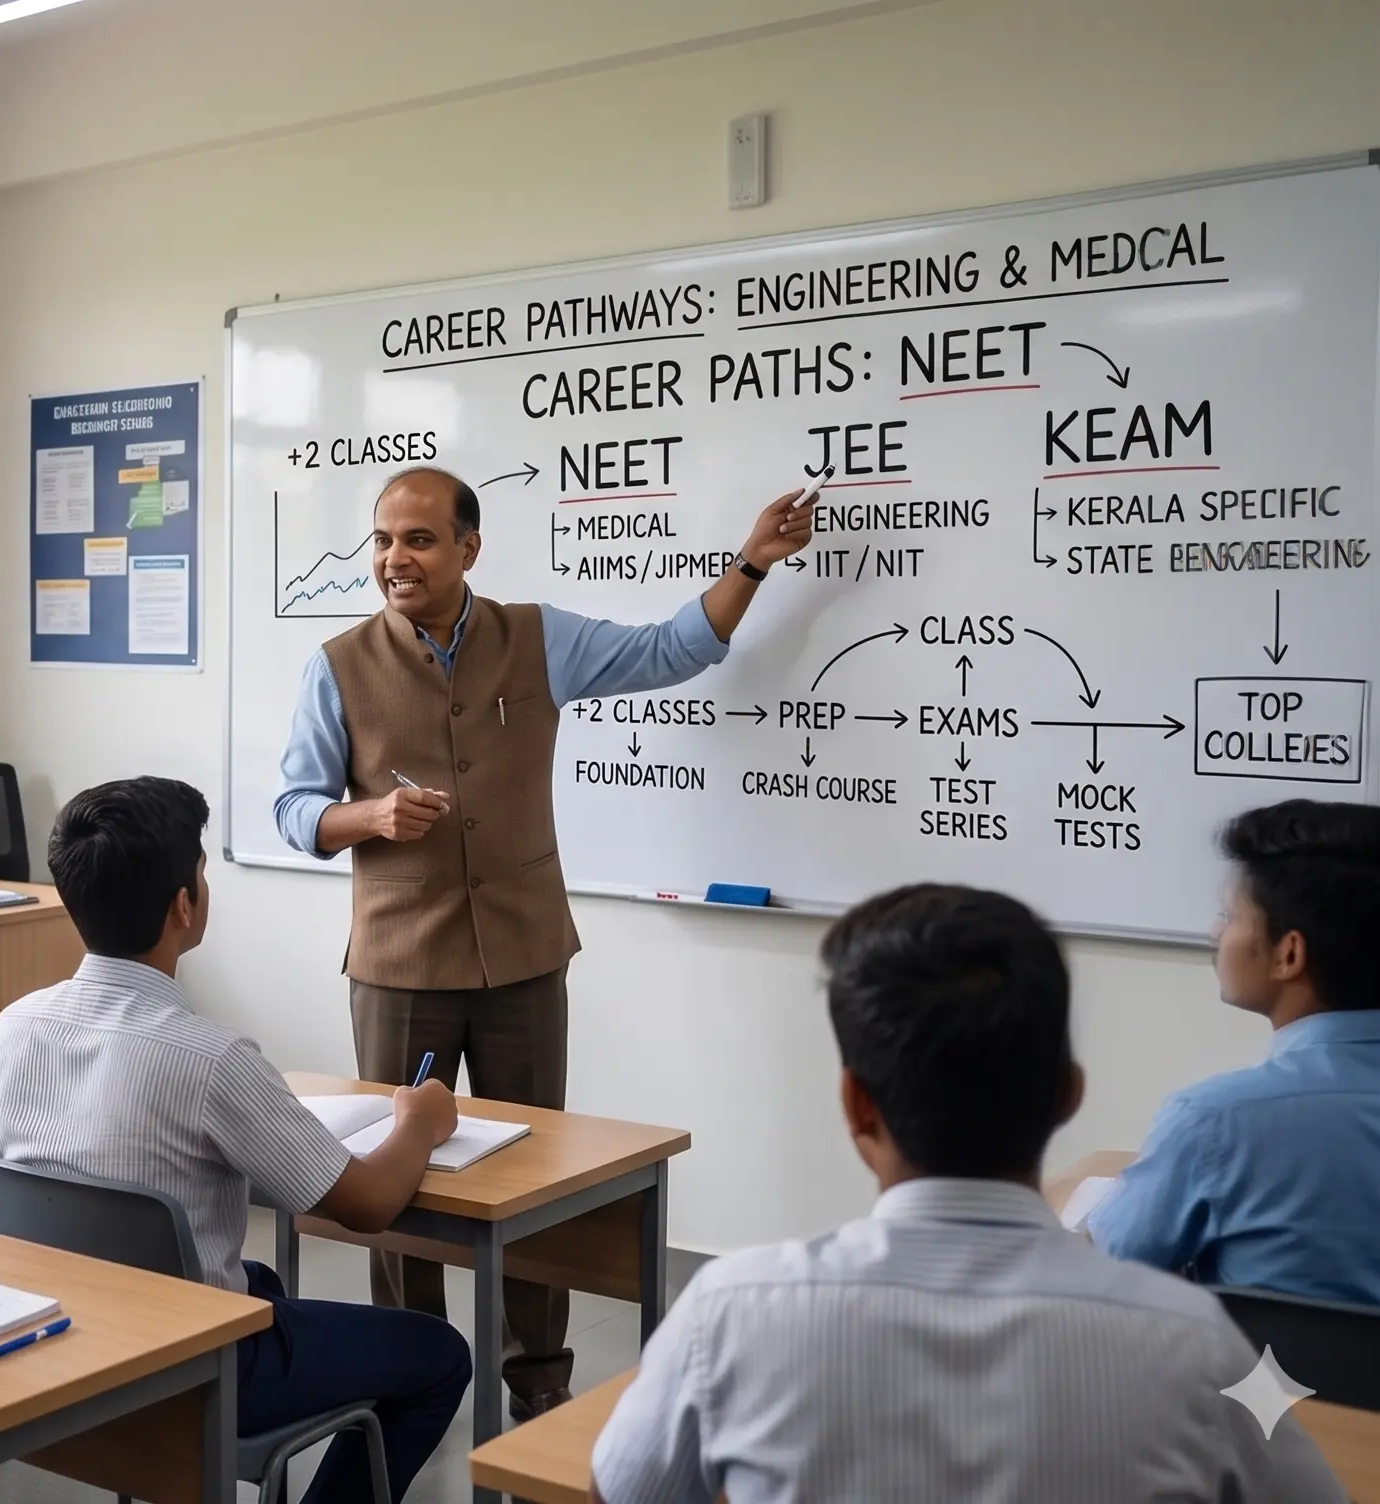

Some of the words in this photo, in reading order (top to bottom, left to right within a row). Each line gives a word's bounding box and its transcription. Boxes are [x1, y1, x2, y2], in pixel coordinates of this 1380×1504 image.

[382, 307, 507, 358] CAREER
[527, 283, 716, 342] PATHWAYS:
[737, 250, 980, 318] ENGINEERING
[999, 244, 1028, 289] &
[1051, 220, 1226, 283] MEDCAL
[522, 360, 684, 419] CAREER
[710, 341, 873, 403] PATHS:
[901, 321, 1047, 386] NEET
[1045, 399, 1212, 466] KEAM
[287, 440, 320, 469] +2
[330, 431, 438, 466] CLASSES
[560, 436, 684, 492] NEET
[803, 420, 909, 479] JEE
[813, 499, 991, 533] ENGINEERING
[1068, 493, 1185, 527] KERALA
[1199, 485, 1341, 522] SPECIFIC
[577, 512, 678, 541] MEDICAL
[816, 550, 850, 578] IIT
[876, 548, 925, 578] NIT
[1066, 544, 1154, 575] STATE
[920, 615, 1015, 645] CLASS
[572, 698, 603, 722] +2
[613, 699, 716, 726] CLASSES
[779, 700, 846, 731] PREP
[919, 705, 1019, 738] EXAMS
[1237, 691, 1304, 723] TOP
[576, 760, 705, 791] FOUNDATION
[742, 771, 808, 799] CRASH
[816, 775, 897, 804] COURSE
[929, 776, 997, 806] TEST
[1058, 782, 1137, 814] MOCK
[919, 809, 1008, 841] SERIES
[1053, 818, 1141, 851] TESTS
